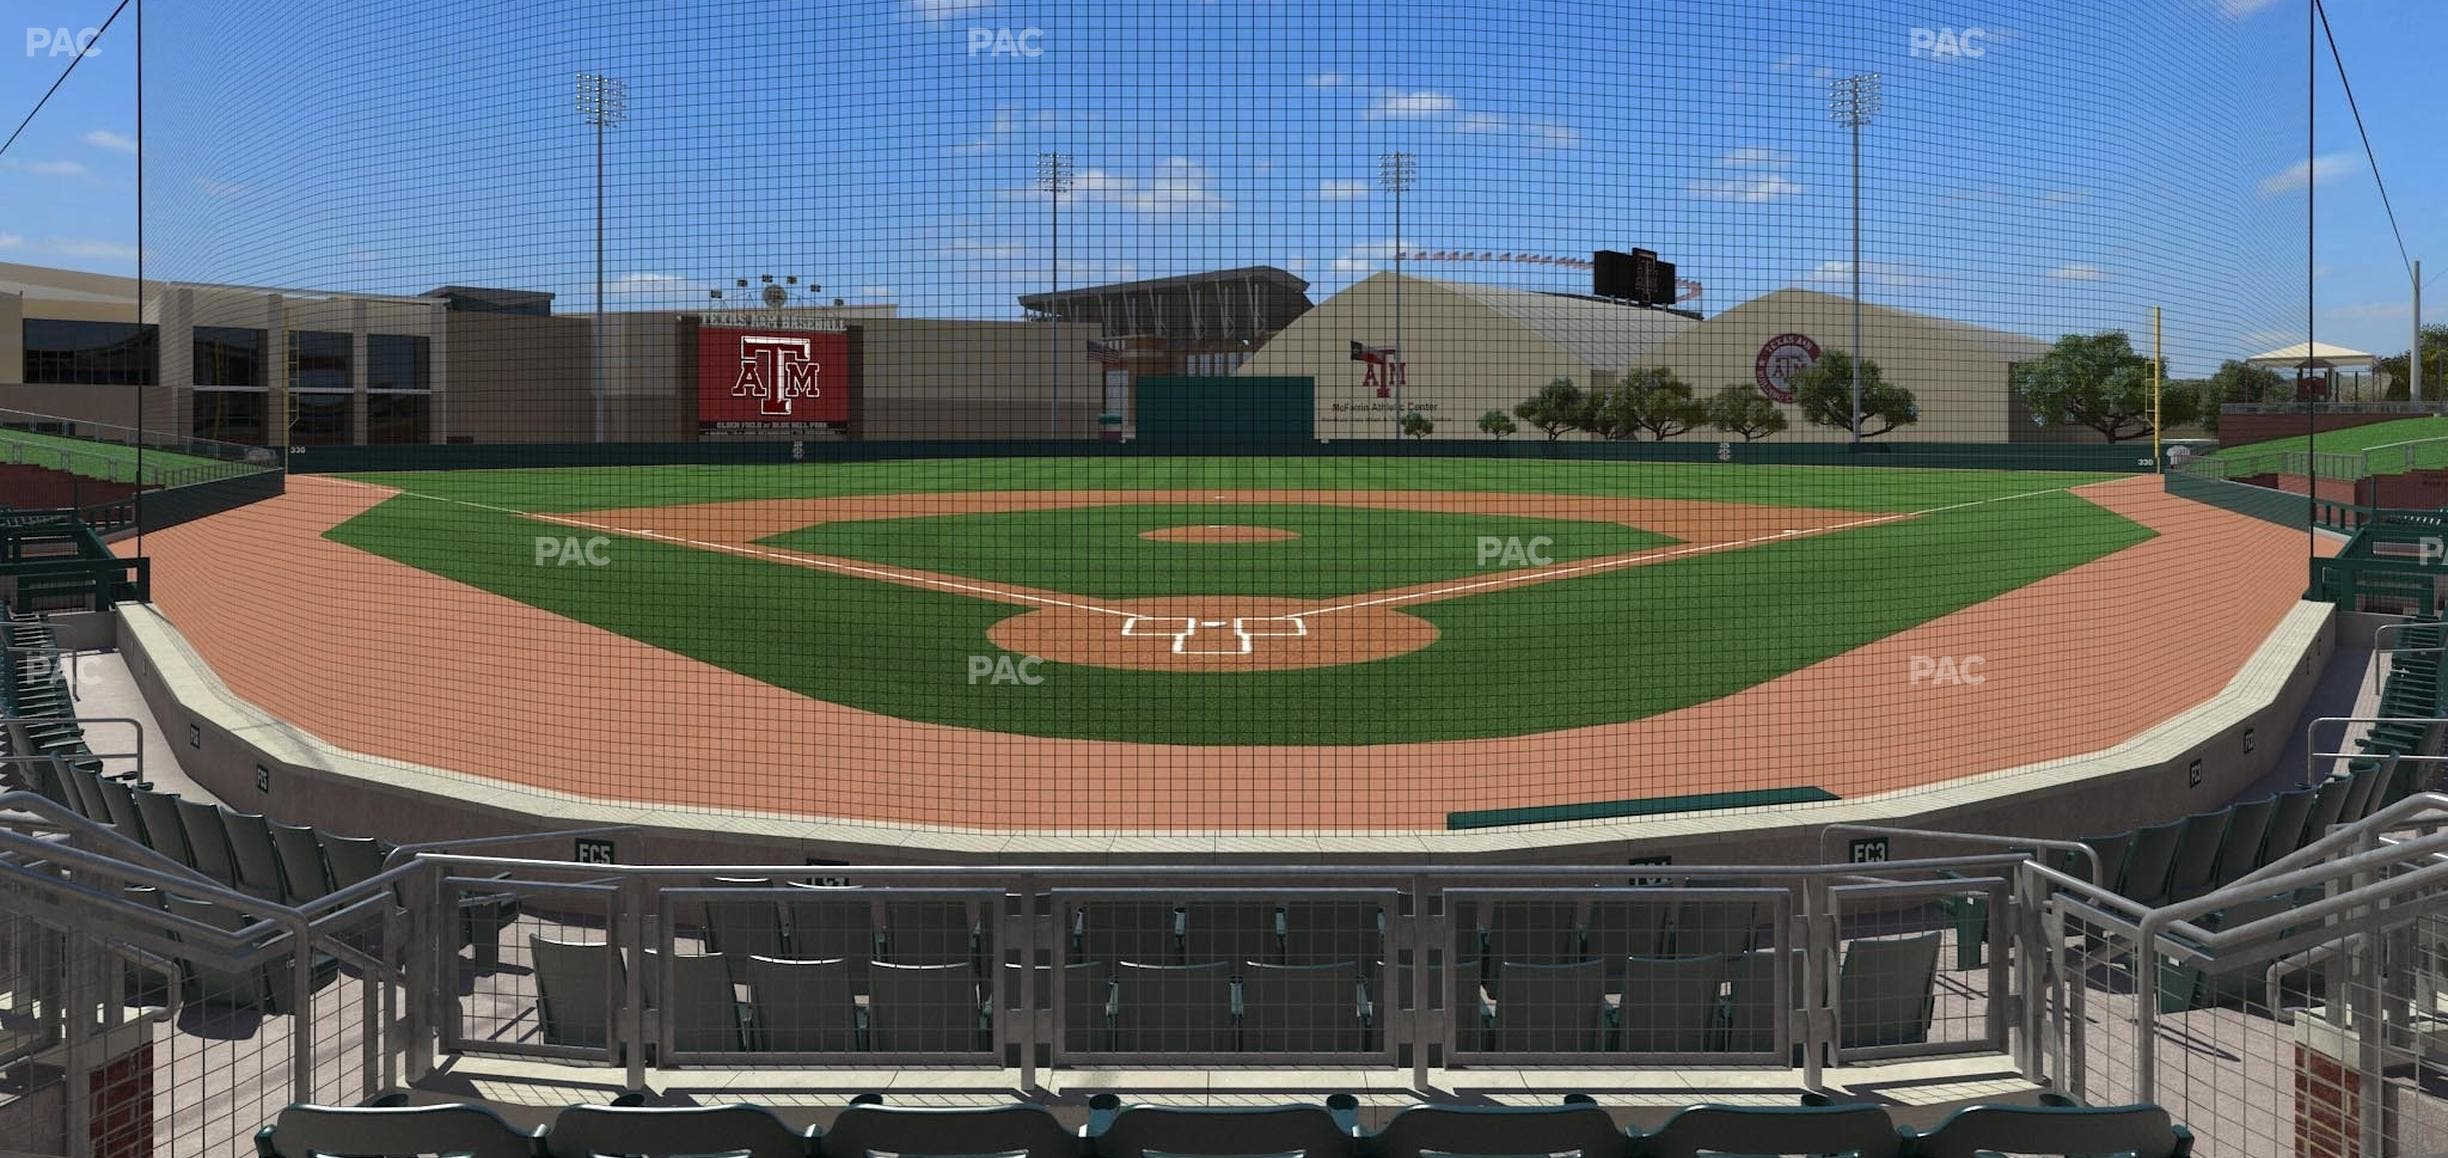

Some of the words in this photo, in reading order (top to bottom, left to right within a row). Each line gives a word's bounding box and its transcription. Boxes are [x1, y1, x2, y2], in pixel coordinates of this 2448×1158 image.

[702, 312, 746, 327] TEXAS
[781, 318, 847, 331] BASEBALL
[290, 446, 306, 454] 330
[2137, 458, 2154, 466] 330
[580, 844, 610, 864] FC5
[1855, 843, 1885, 863] FC3
